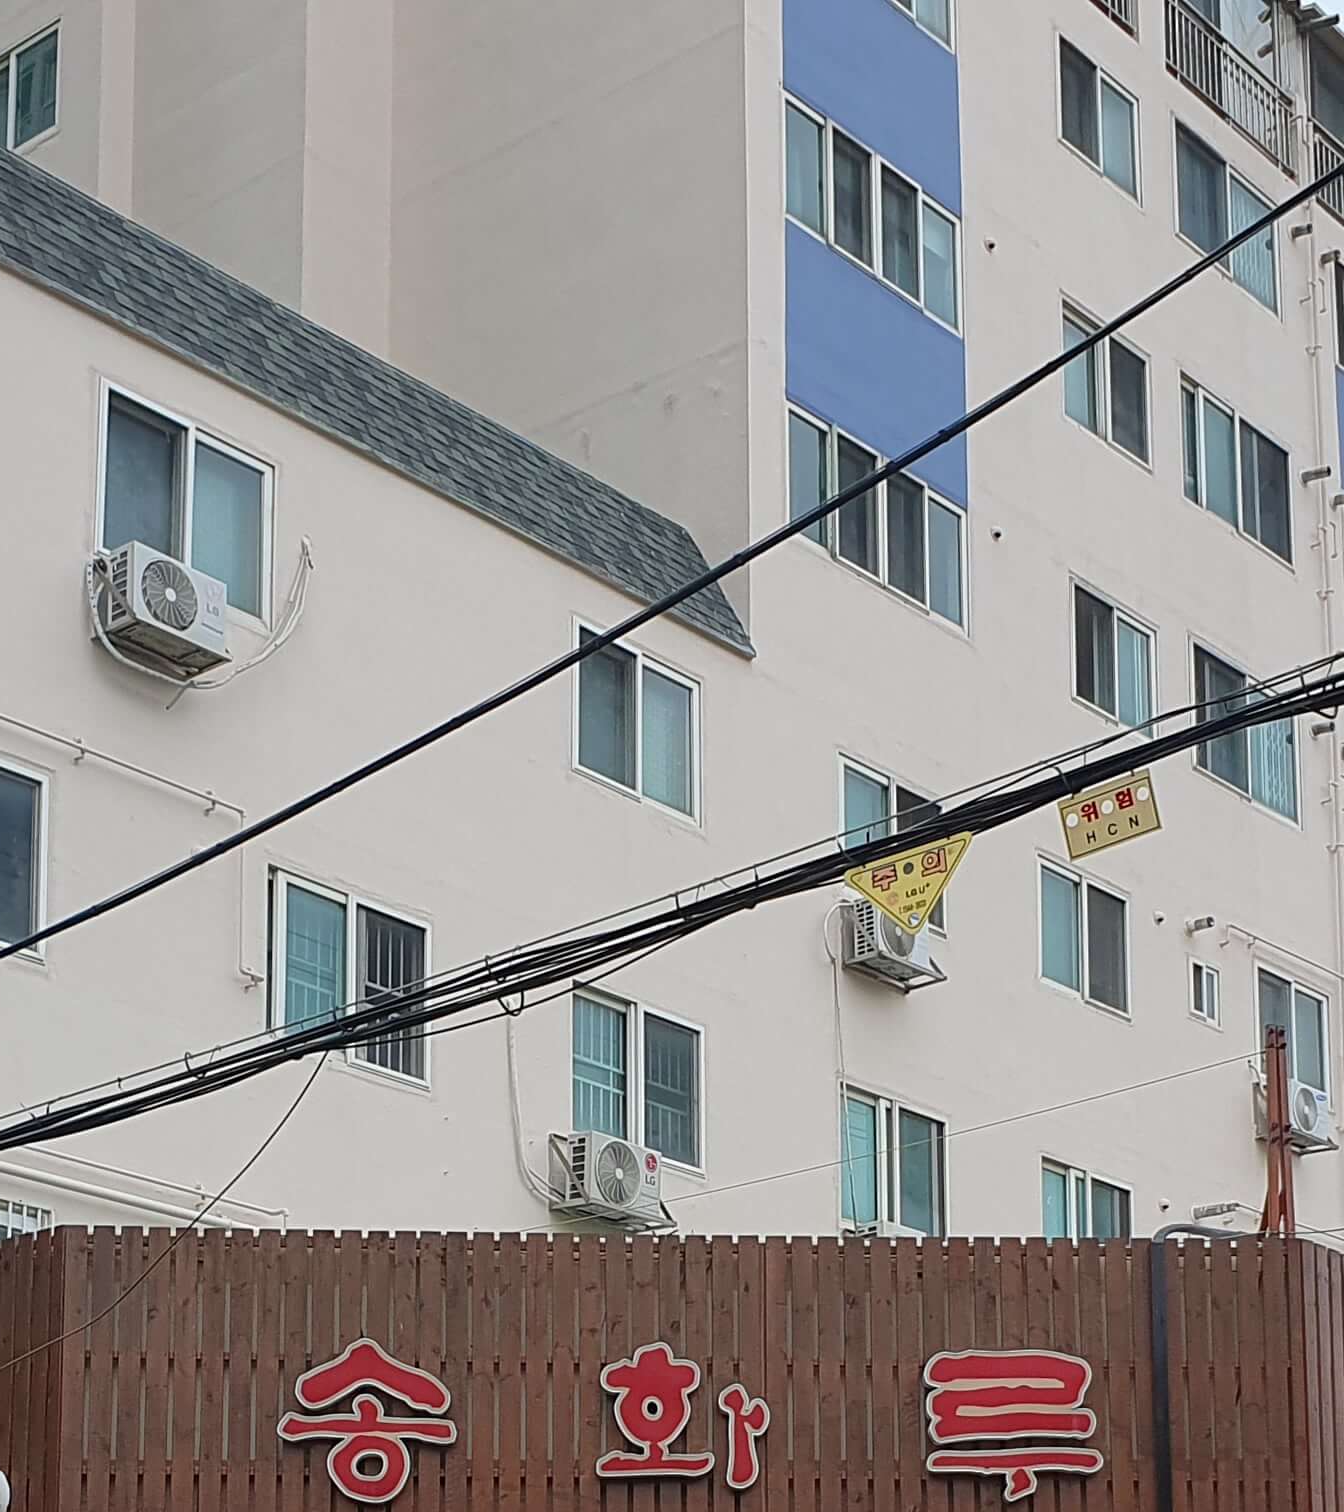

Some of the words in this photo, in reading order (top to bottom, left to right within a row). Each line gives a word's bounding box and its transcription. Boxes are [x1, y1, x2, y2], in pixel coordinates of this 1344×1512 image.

[1080, 787, 1134, 824] 위험
[1085, 814, 1141, 846] HCN
[871, 847, 948, 892] 주의
[277, 1336, 1105, 1505] 송화루
